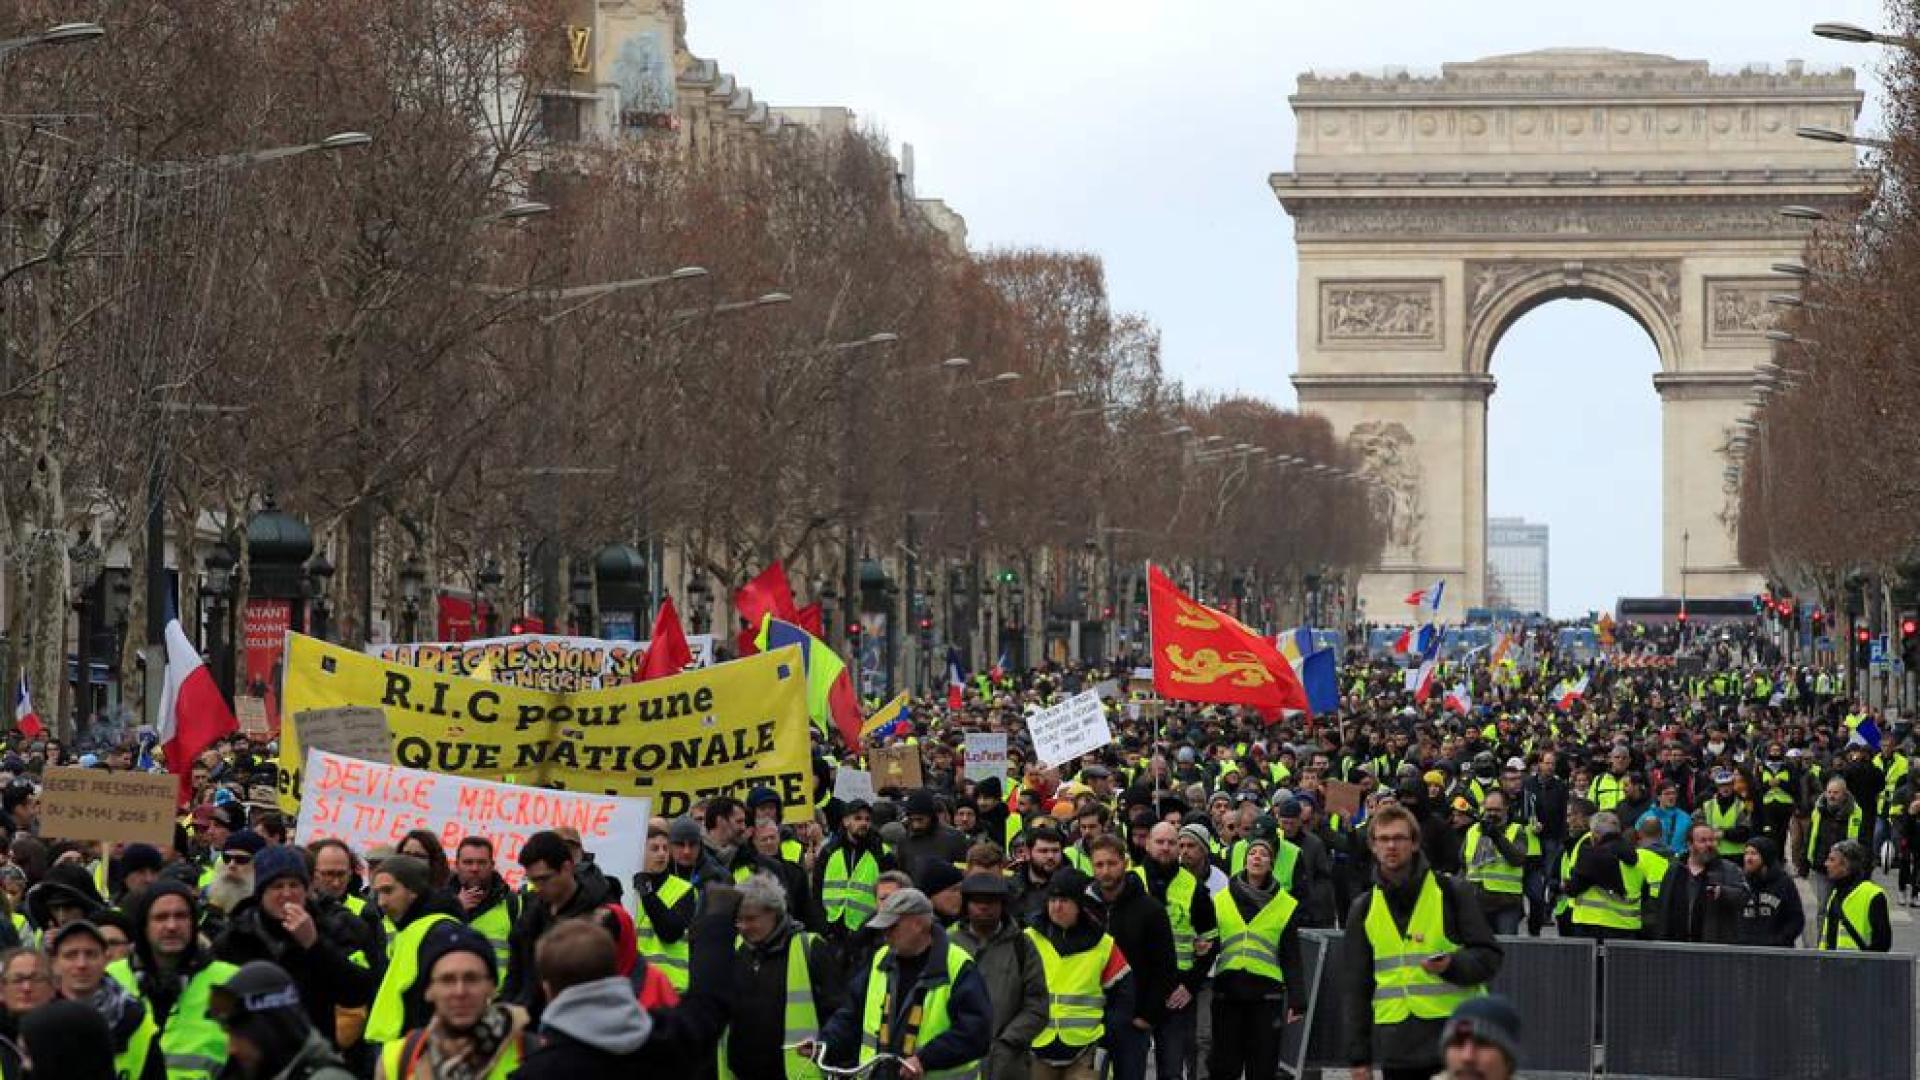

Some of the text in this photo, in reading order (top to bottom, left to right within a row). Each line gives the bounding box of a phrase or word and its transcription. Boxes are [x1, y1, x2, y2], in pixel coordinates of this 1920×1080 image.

[381, 670, 713, 731] R.I.C pour une
[391, 720, 777, 772] QUE NATIONALE
[352, 803, 386, 833] TU
[456, 784, 617, 838] MACRONNE
